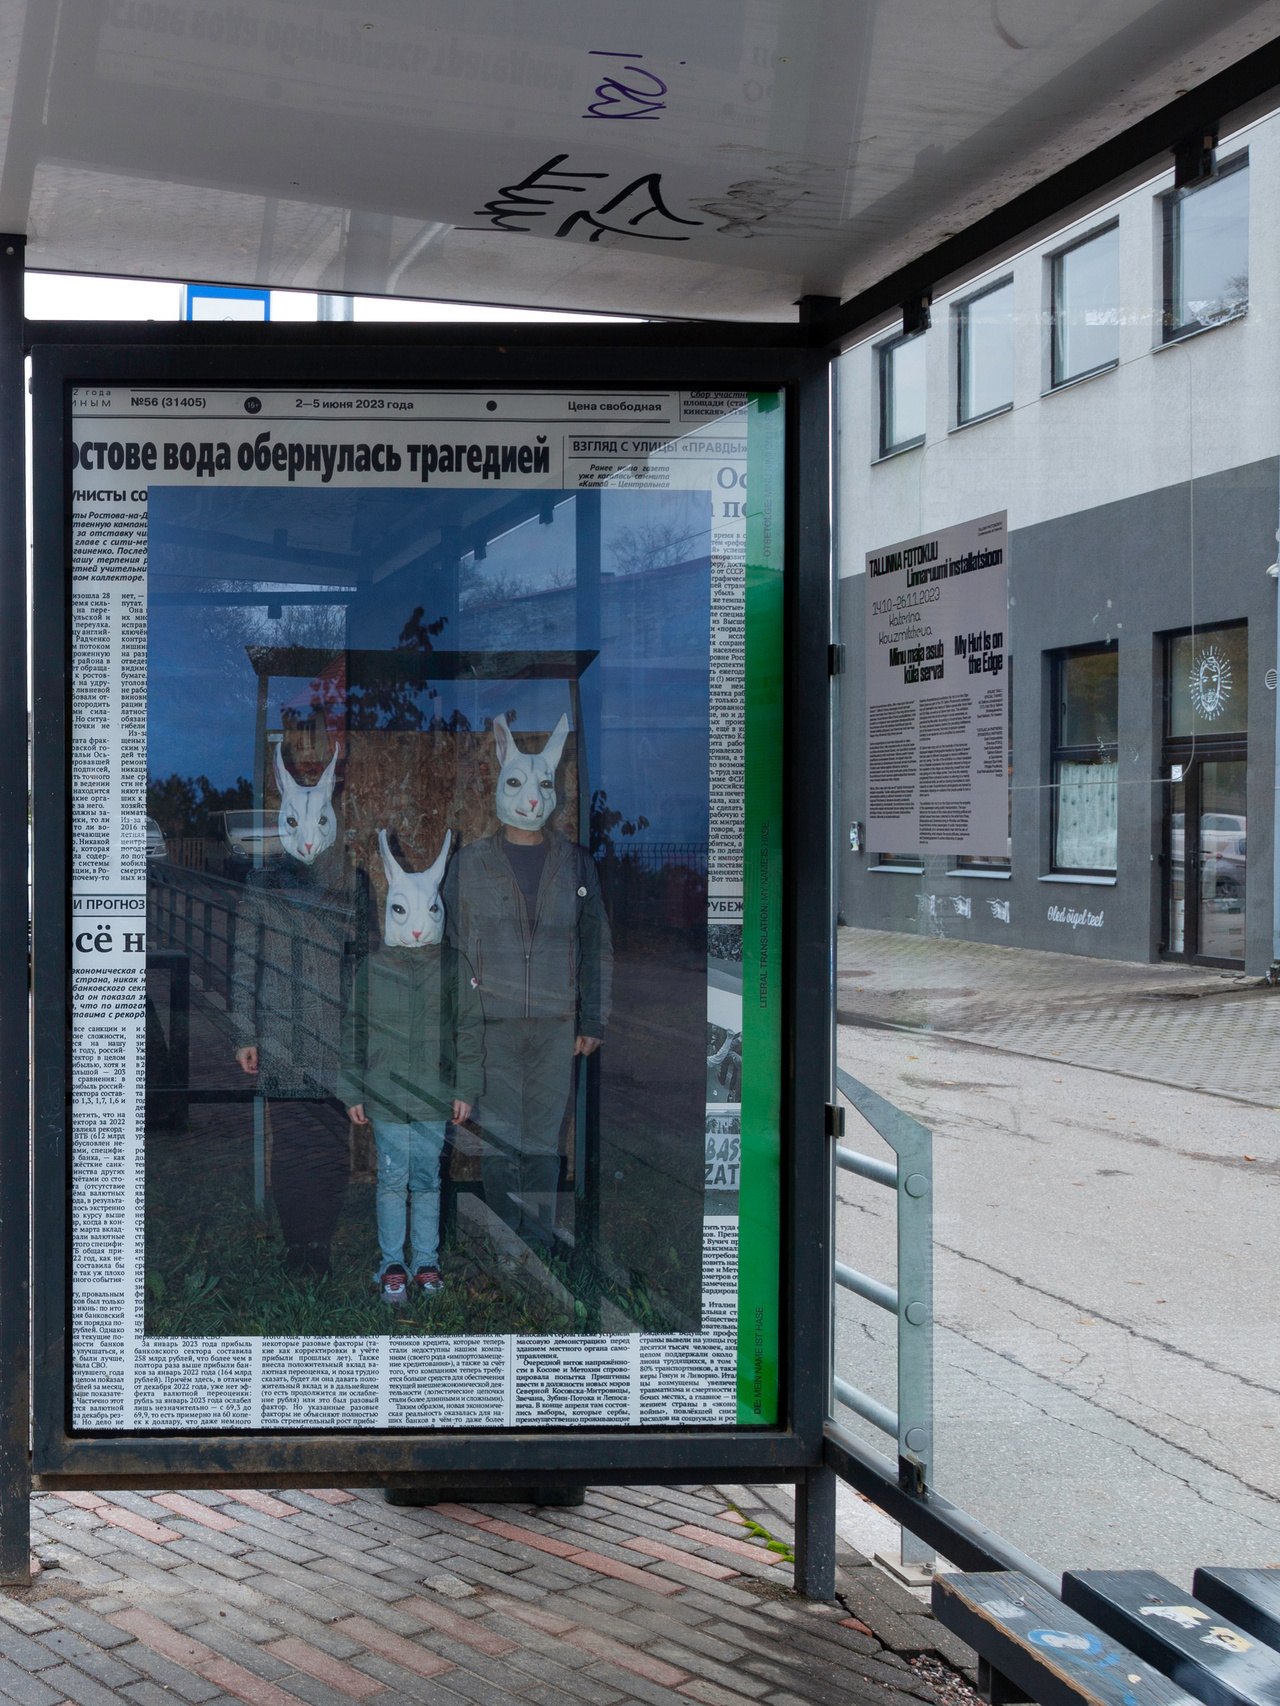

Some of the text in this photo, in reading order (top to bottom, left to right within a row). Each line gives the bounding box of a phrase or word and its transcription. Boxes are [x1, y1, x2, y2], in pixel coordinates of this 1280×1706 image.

[131, 397, 207, 409] №56 (31405)
[355, 400, 385, 409] 2023
[387, 403, 414, 411] года
[568, 401, 661, 413] Цена свободная
[164, 442, 231, 477] вода
[237, 431, 401, 483] обернулась
[407, 435, 550, 483] трагедией
[573, 441, 747, 454] ВЗГЛЯД С УЛИЦЫ «ПРАВДЫ»
[869, 541, 938, 578] TALLINNA FOTOKUU
[949, 548, 1003, 577] installatsioon
[889, 612, 921, 628] Katerina
[889, 639, 944, 667] Minu maja asub
[954, 630, 1003, 659] My Hut Is on
[904, 659, 944, 684] küla serval
[968, 651, 1003, 676] the Edge
[761, 859, 769, 885] NAME
[761, 886, 769, 900] MY
[74, 900, 145, 909] И ПРОГНОЗ
[760, 903, 769, 968] TRANSLATION:
[759, 971, 768, 1008] LITERAL
[755, 1333, 763, 1347] IST
[755, 1352, 763, 1374] NAME
[754, 1376, 762, 1398] MEIN
[753, 1401, 762, 1415] DE:
